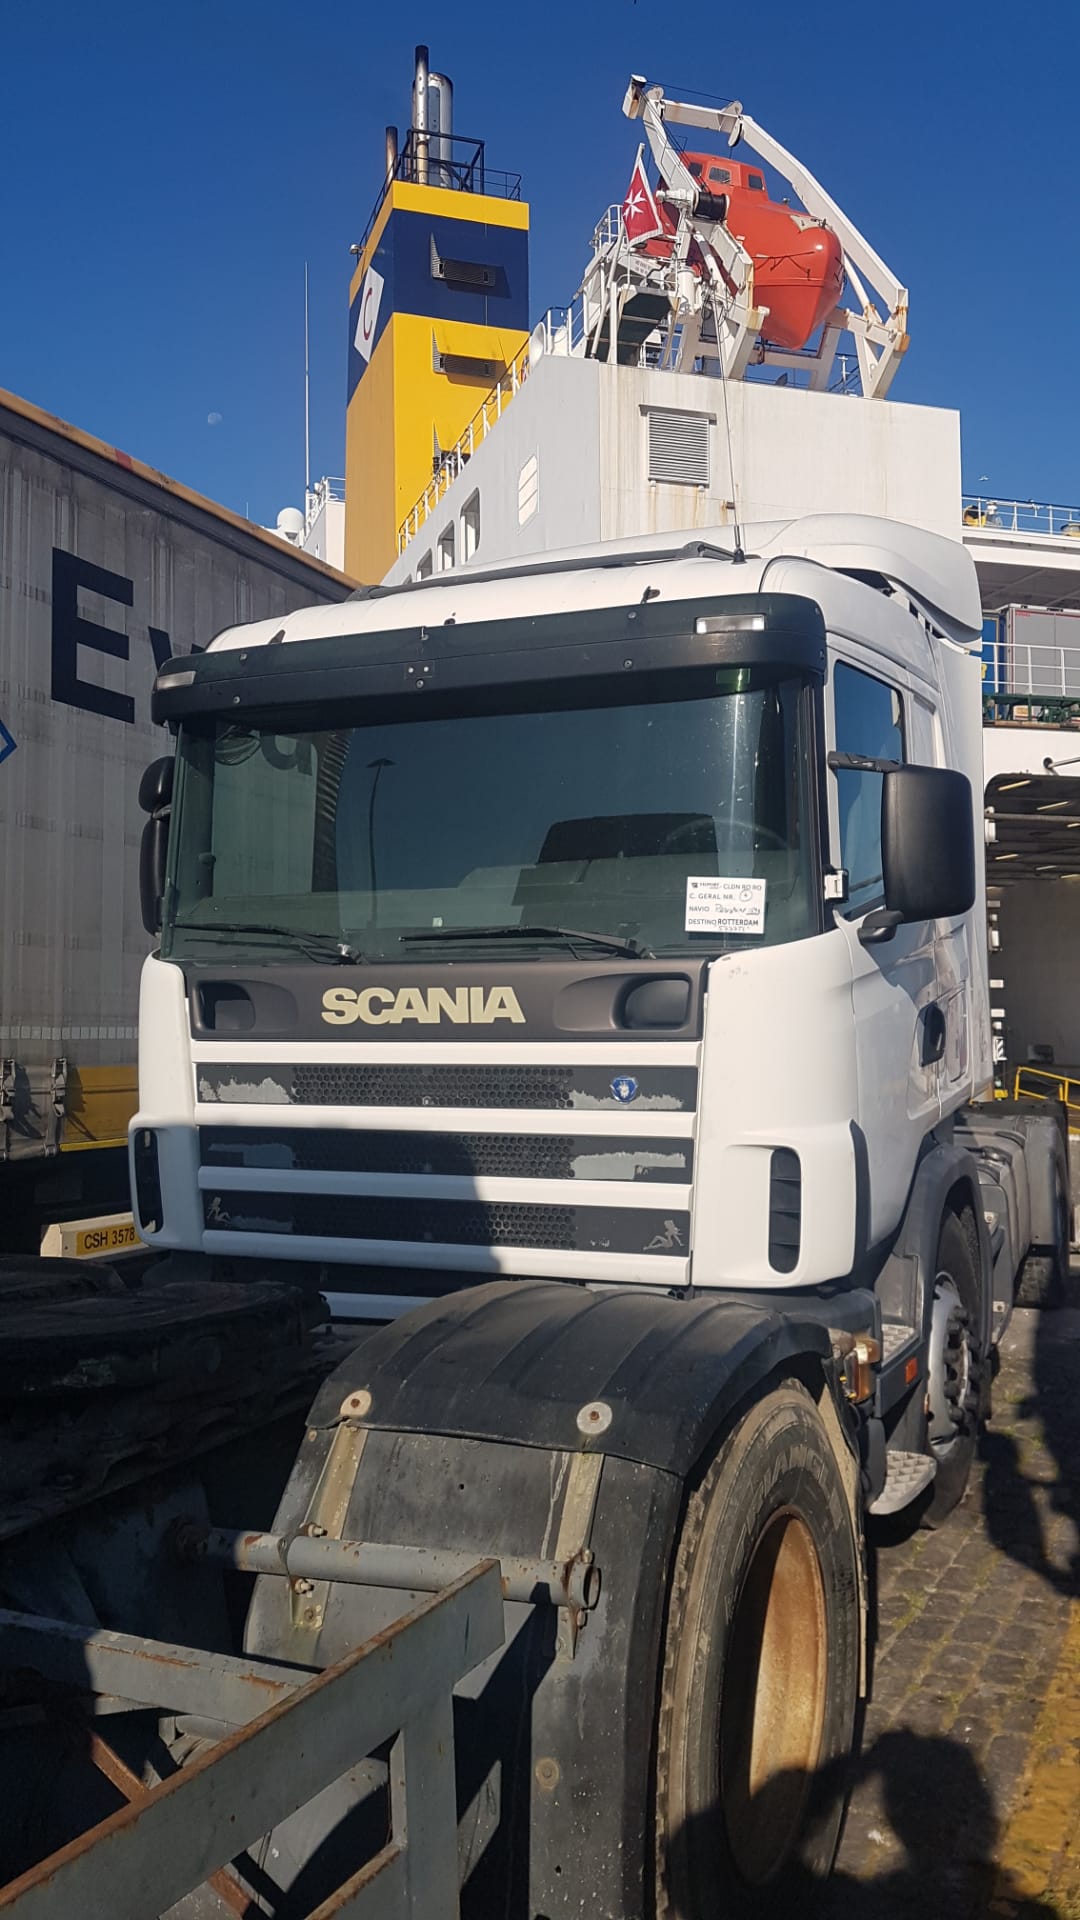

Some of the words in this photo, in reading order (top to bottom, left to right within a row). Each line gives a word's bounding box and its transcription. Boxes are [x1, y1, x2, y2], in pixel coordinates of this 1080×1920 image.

[698, 892, 721, 900] GERAL
[688, 918, 717, 926] DESTINO
[717, 918, 759, 927] ROTTERDAM
[321, 986, 526, 1025] SCANIA
[84, 1231, 108, 1249] CSH
[112, 1227, 135, 1245] 3578
[731, 1445, 844, 1576] TRIANGLE
